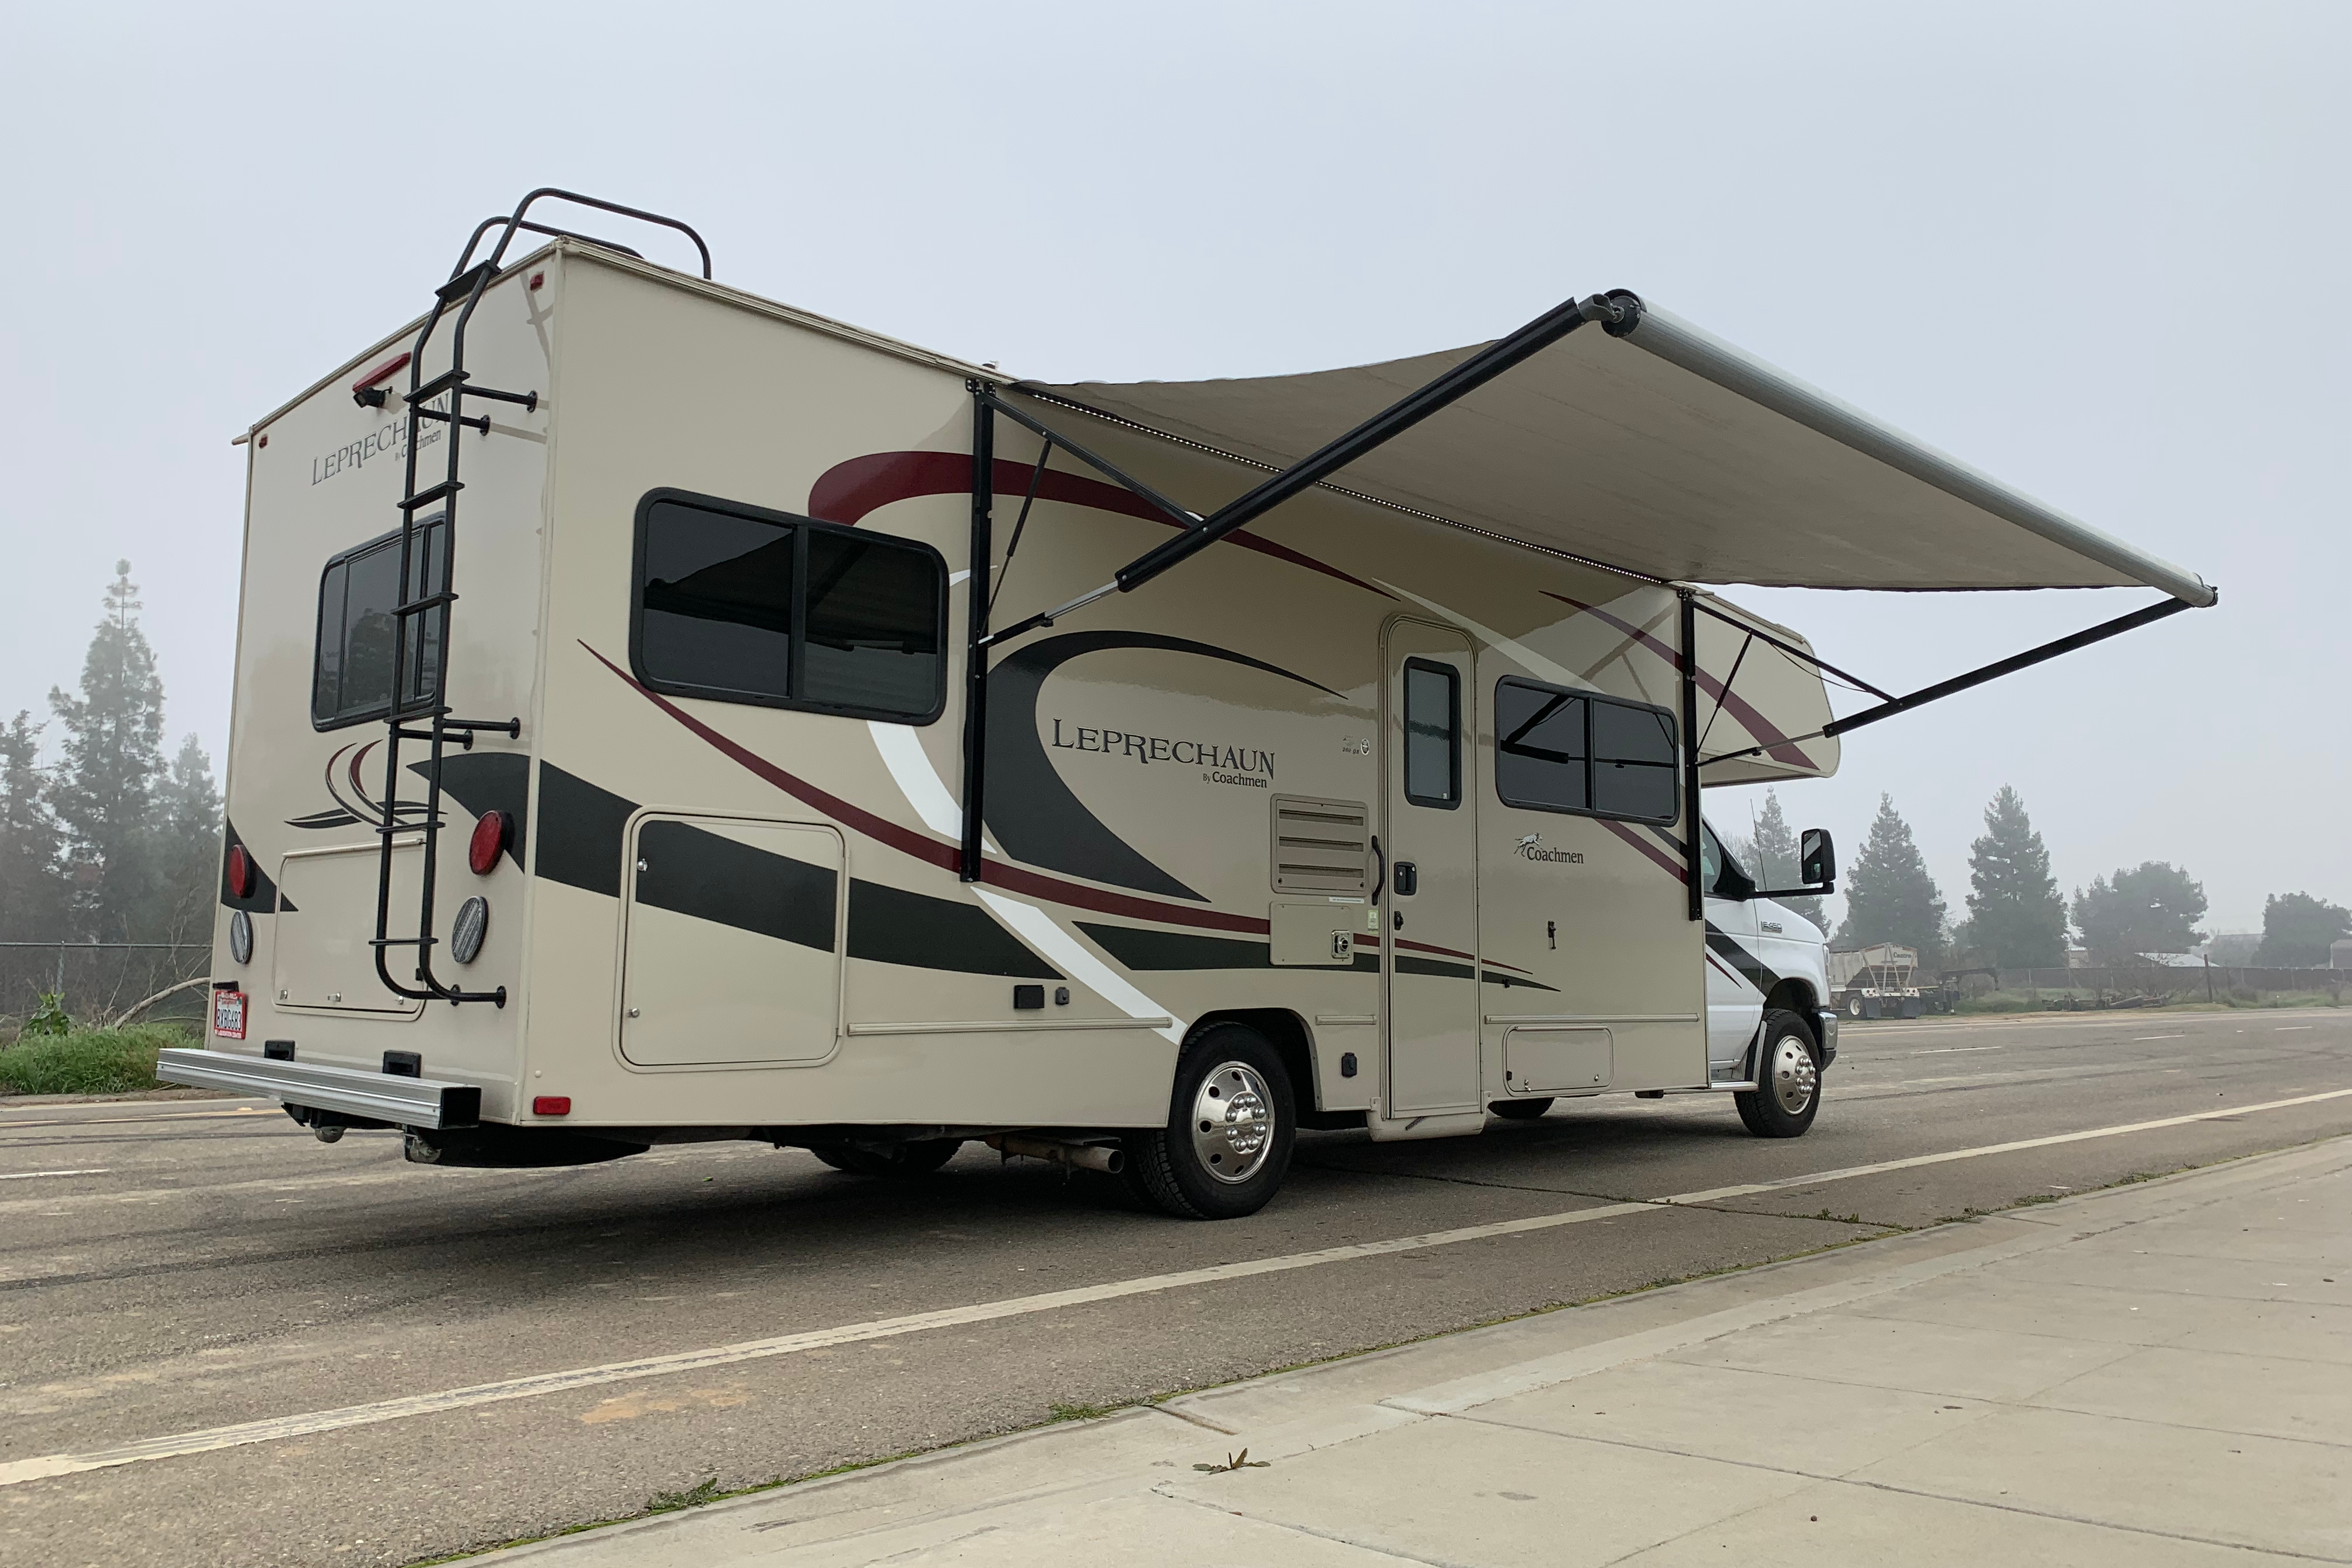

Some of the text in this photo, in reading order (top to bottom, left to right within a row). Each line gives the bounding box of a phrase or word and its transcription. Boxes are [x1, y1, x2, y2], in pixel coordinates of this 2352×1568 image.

[312, 391, 450, 486] LEPRECHUN
[1052, 718, 1275, 780] LEPRECHAUN
[1203, 771, 1267, 789] By Coachmen
[1527, 846, 1584, 864] Coachmen
[216, 1008, 242, 1031] 8XBG683
